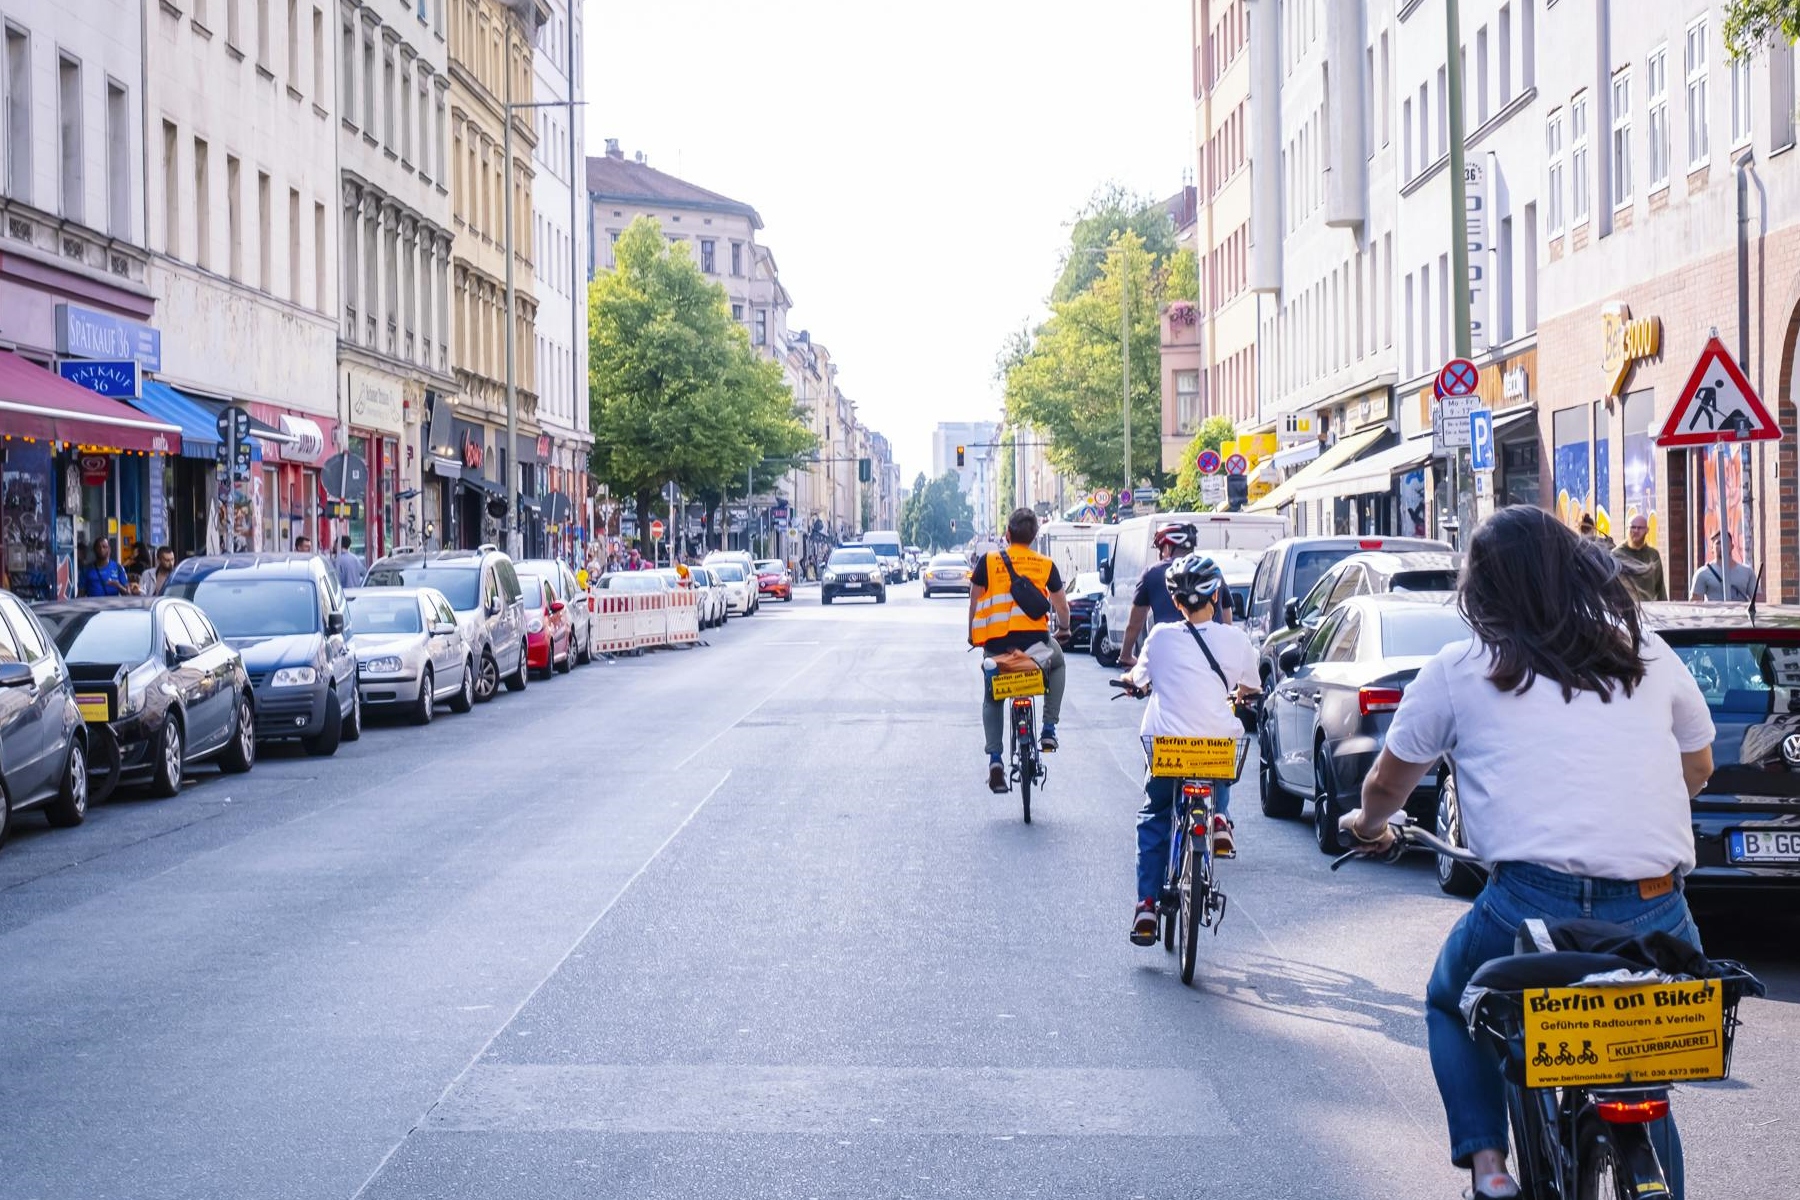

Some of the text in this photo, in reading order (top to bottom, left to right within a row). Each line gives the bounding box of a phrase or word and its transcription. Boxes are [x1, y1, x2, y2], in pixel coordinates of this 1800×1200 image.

[70, 314, 116, 355] SPÄTKAUF
[117, 326, 130, 358] 36
[1623, 317, 1652, 361] 3000
[71, 365, 133, 388] PÄTKAUF
[91, 378, 109, 392] 36
[1448, 400, 1459, 408] Mo
[1474, 417, 1488, 463] P
[1156, 737, 1234, 748] Berlin on Bike!
[1745, 833, 1761, 854] B
[1530, 986, 1716, 1013] Berlin on Bike!
[1540, 1013, 1705, 1031] Geführte Radtouren & Verleih
[1615, 1035, 1710, 1057] KULTURBRAUEREI
[1634, 1069, 1648, 1078] Tel.
[1651, 1069, 1666, 1077] 030
